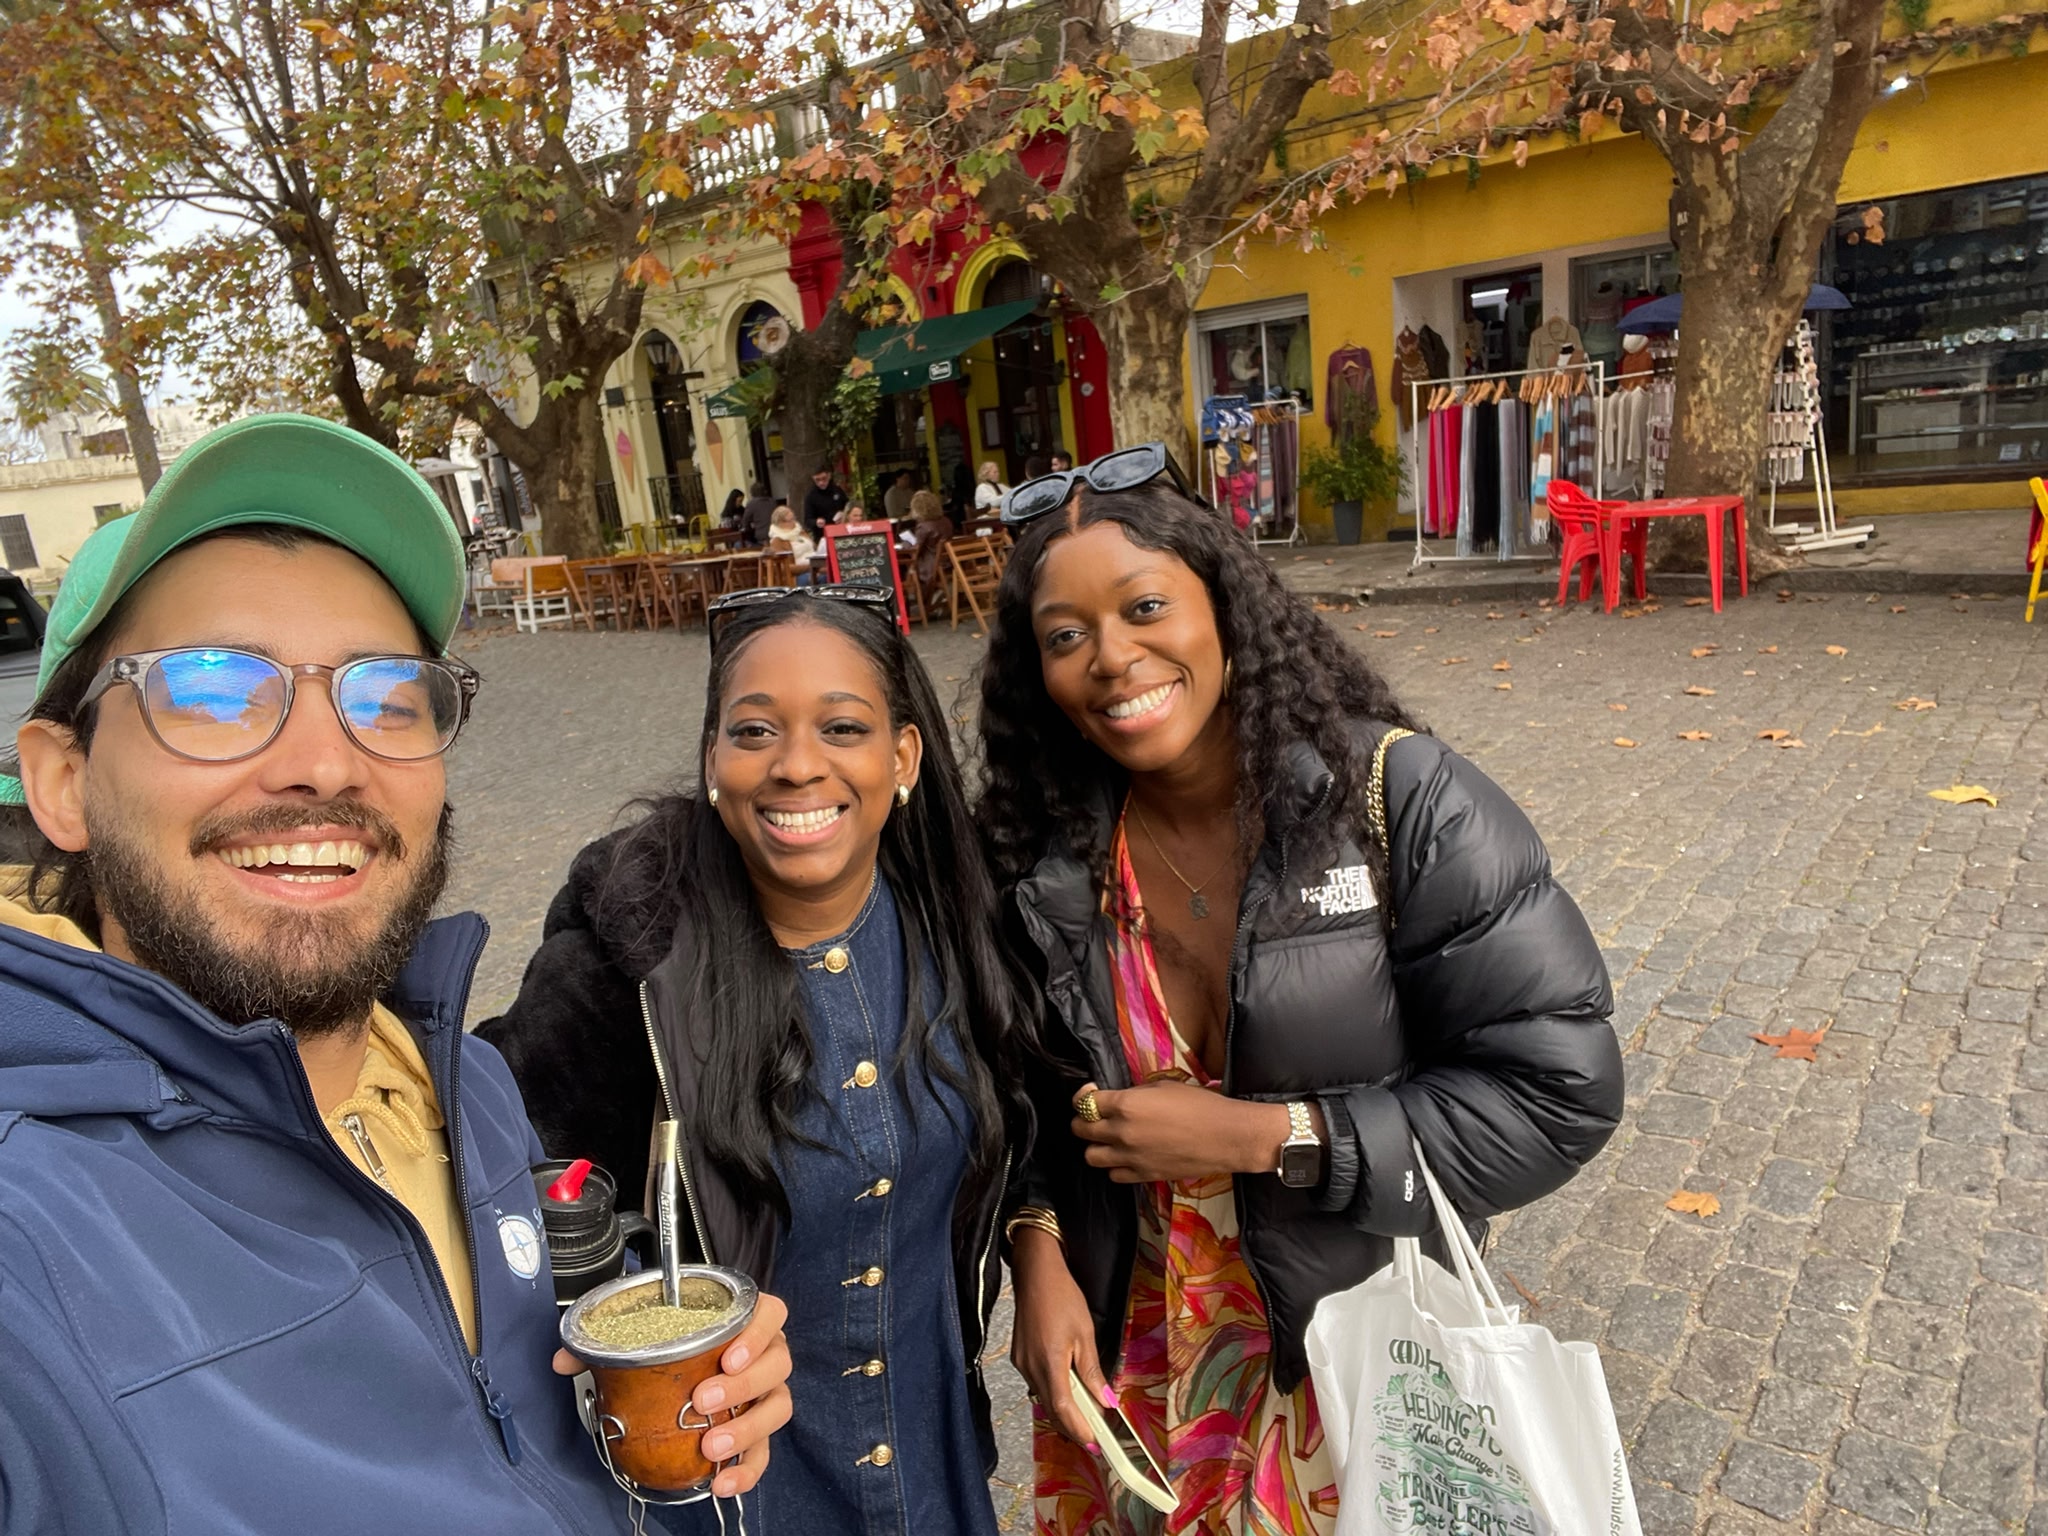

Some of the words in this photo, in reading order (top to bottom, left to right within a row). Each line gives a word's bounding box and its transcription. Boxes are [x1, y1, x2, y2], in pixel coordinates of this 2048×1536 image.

[1325, 867, 1361, 885] THE
[1300, 882, 1361, 904] NORTH
[1320, 897, 1362, 916] FACE
[1445, 1436, 1495, 1478] Change
